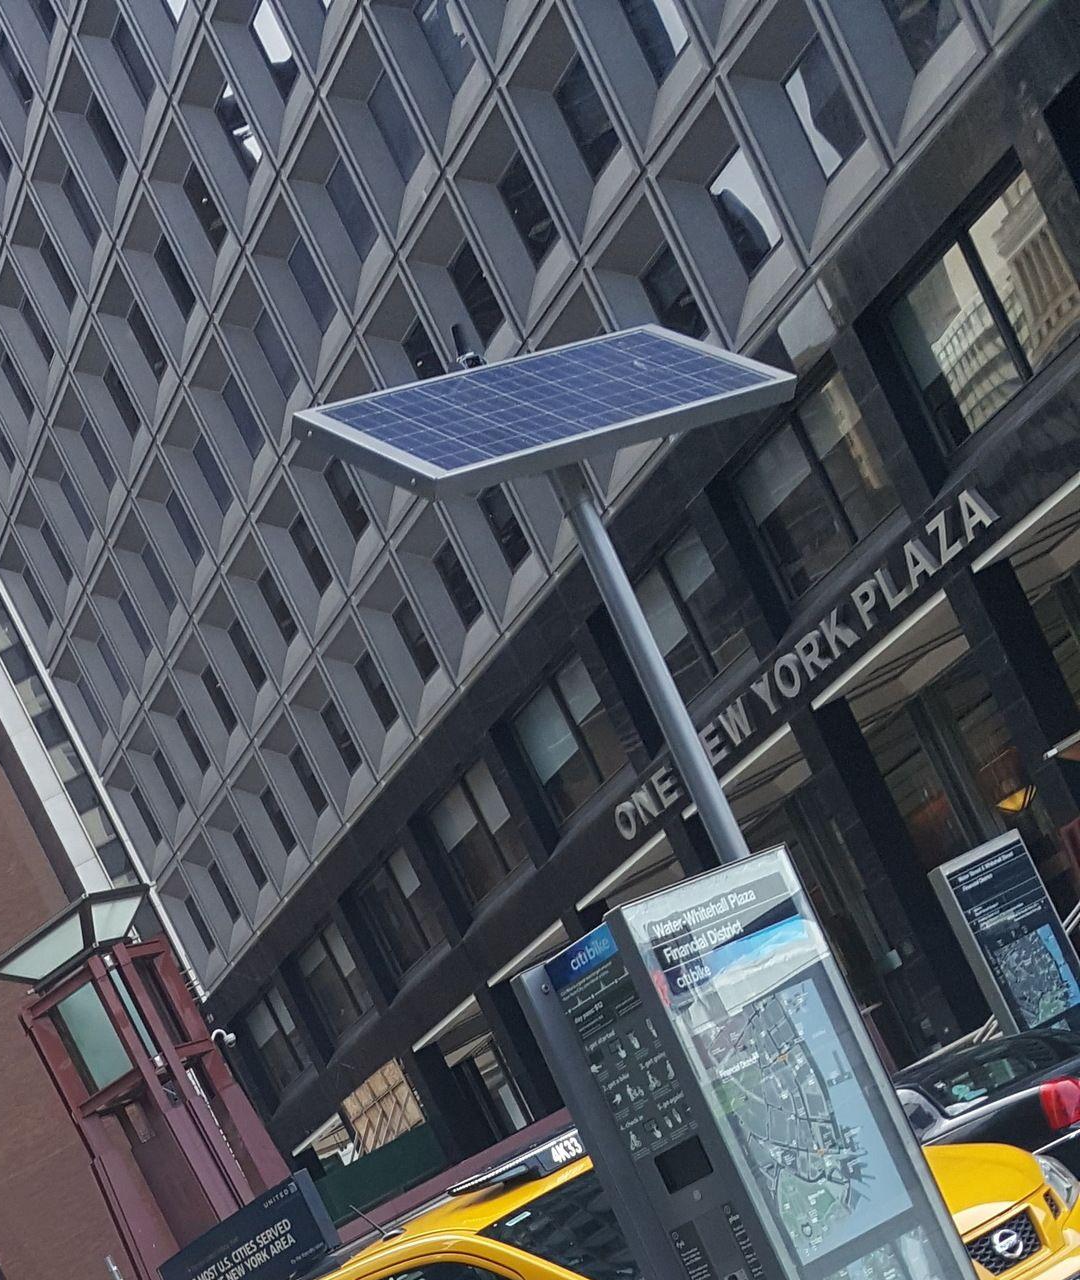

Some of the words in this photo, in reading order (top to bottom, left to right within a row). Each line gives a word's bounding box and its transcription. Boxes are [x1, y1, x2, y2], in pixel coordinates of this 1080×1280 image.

[614, 766, 680, 840] ONE
[698, 697, 758, 766] EW
[751, 608, 860, 716] YORK
[850, 490, 1001, 631] PLAZA
[652, 898, 728, 938] Water-Whitehall
[728, 888, 756, 909] Plaza
[663, 933, 707, 964] Financial
[707, 920, 744, 945] District
[551, 1137, 583, 1163] 4K33
[263, 1188, 289, 1208] UNITED
[218, 1256, 233, 1273] U.S.
[232, 1240, 256, 1262] CITIES
[256, 1218, 291, 1247] SERVED
[245, 1249, 269, 1272] YORK
[269, 1233, 296, 1256] AREA
